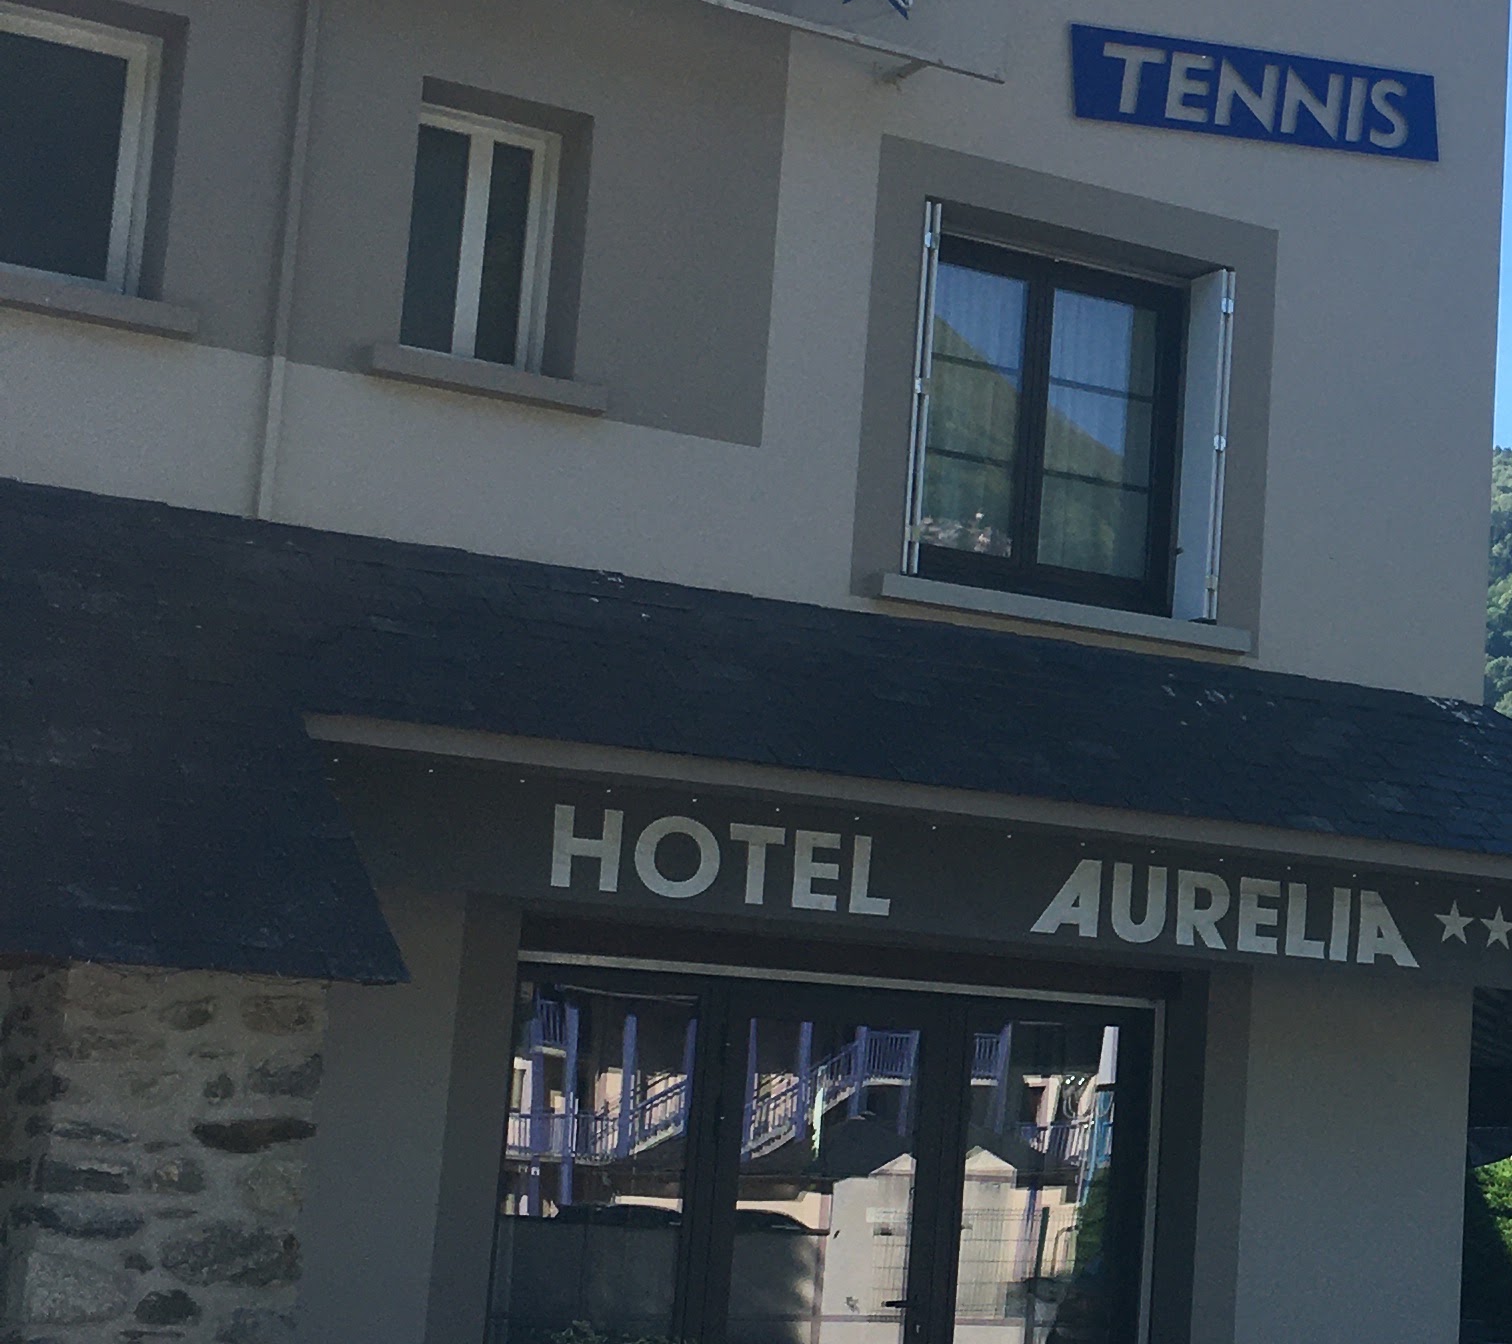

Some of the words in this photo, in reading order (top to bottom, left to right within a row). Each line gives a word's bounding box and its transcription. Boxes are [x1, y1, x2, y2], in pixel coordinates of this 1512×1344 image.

[1102, 41, 1409, 149] TENNIS
[550, 803, 891, 916] HOTEL
[1030, 858, 1420, 968] AURELIA
